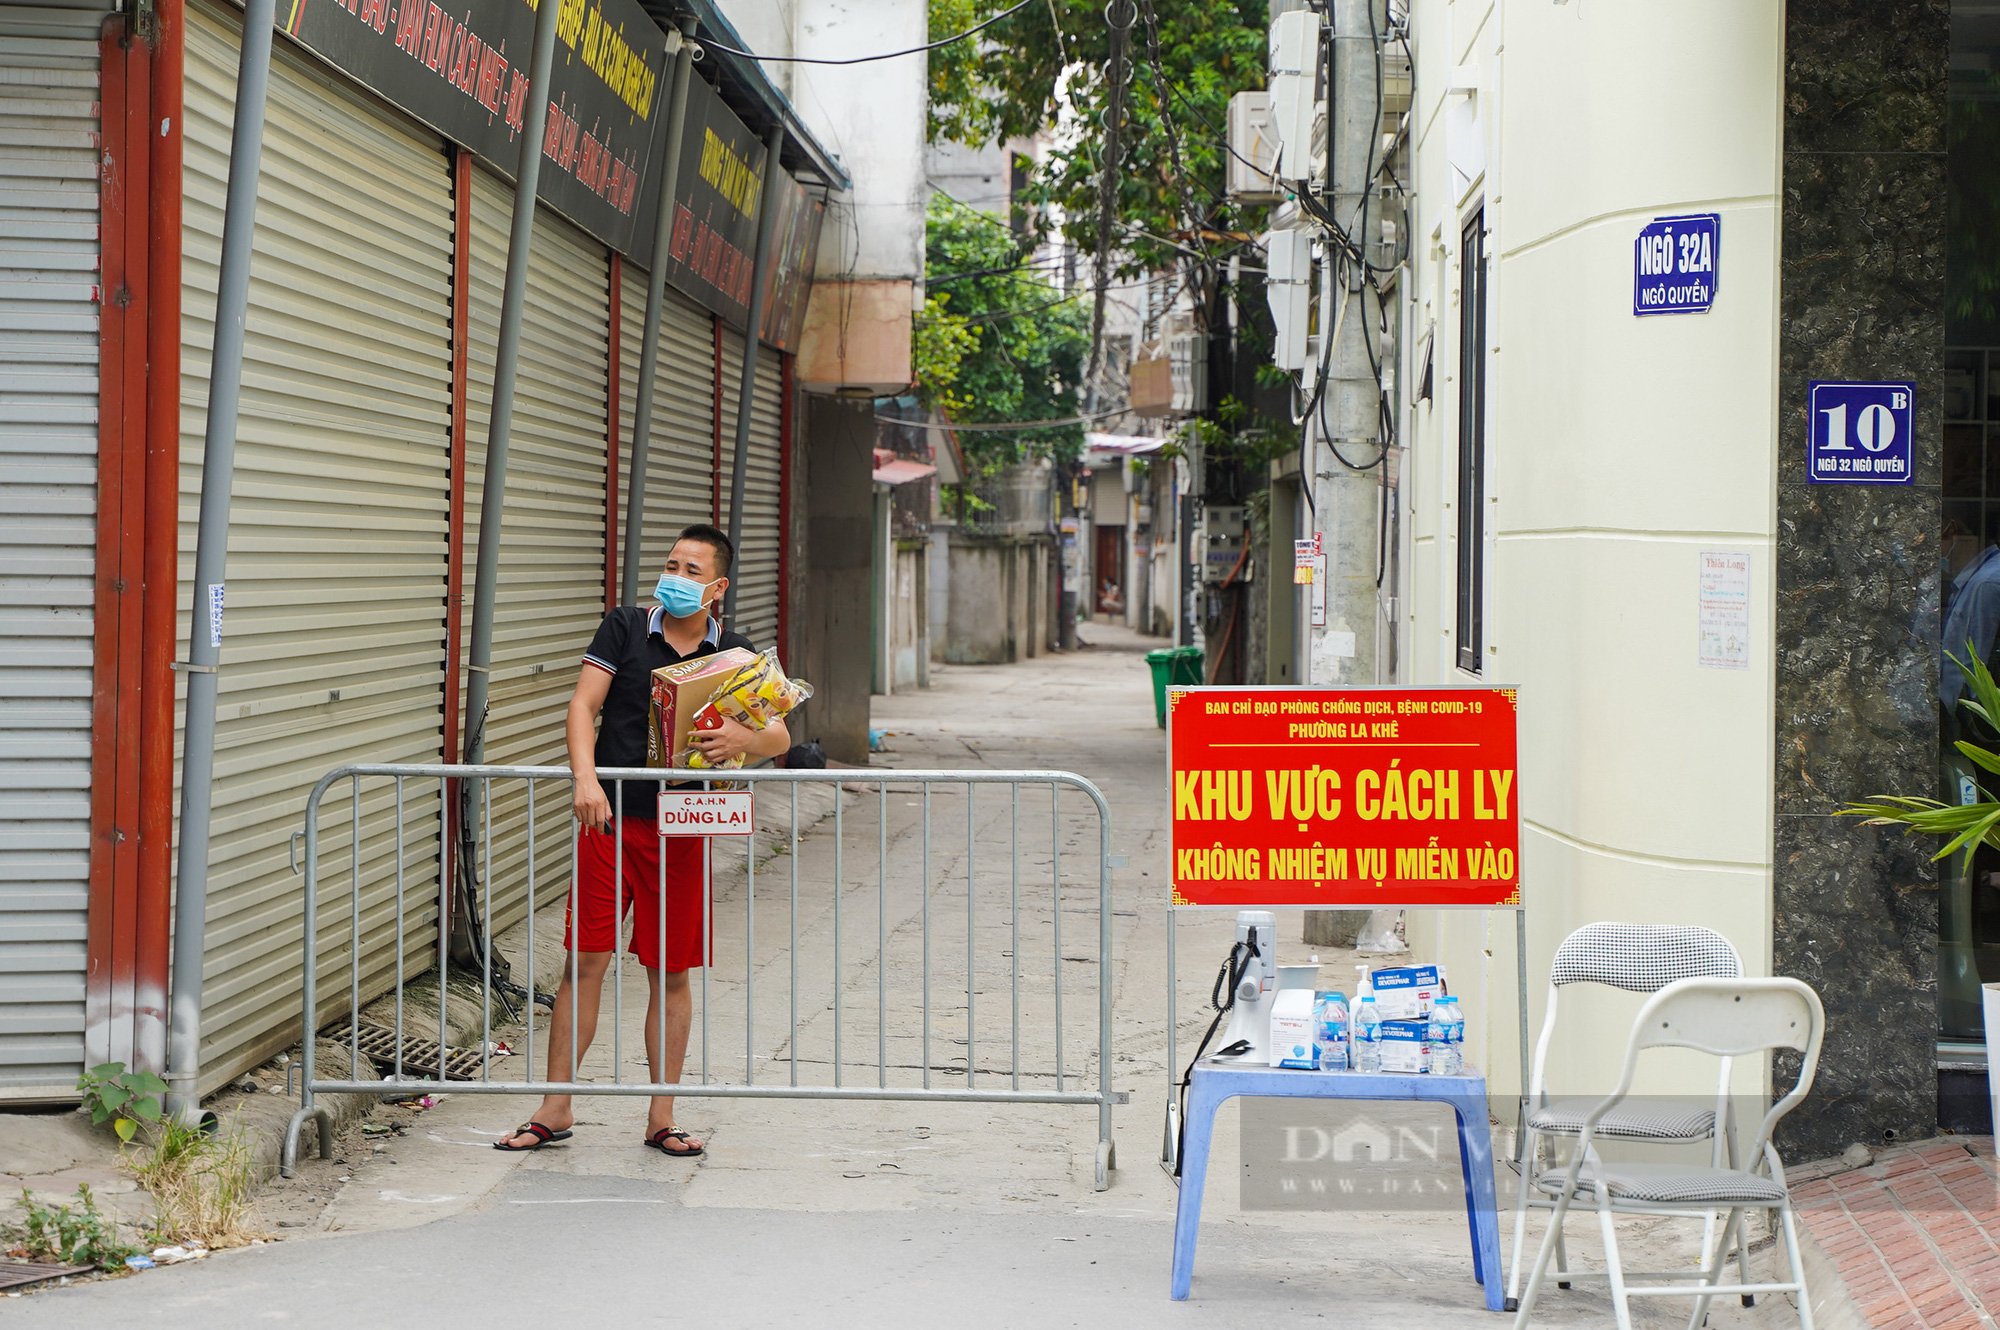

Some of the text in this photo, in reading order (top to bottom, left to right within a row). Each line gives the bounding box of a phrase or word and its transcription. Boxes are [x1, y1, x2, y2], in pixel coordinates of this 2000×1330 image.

[421, 1, 453, 78] FILM
[449, 10, 482, 97] CÁCH
[474, 38, 508, 126] NHIỆT
[505, 68, 530, 142] BỌC
[605, 21, 630, 97] CÔNG
[699, 126, 726, 190] TRUNG
[719, 138, 739, 202] TÂM
[1640, 226, 1712, 275] NGÕ 32A
[1642, 278, 1709, 305] NGÔ QUYỀN
[1817, 454, 1905, 473] NGÕ 32 NGÔ QUYỀN
[1726, 559, 1746, 571] Long
[1205, 697, 1483, 717] BAN CHỈ ĐẠO PHÒNG CHỐNG DỊCH, BỆNH COVID-19
[1289, 719, 1399, 738] PHƯỜNG LA KHÊ
[684, 797, 726, 806] C.A.H.N
[1175, 758, 1514, 832] KHU VỰC CÁCH LY
[665, 807, 747, 827] DỪNG LẠI
[1177, 836, 1514, 888] KHÔNG NHIỆM VỤ MIỄN VÀO
